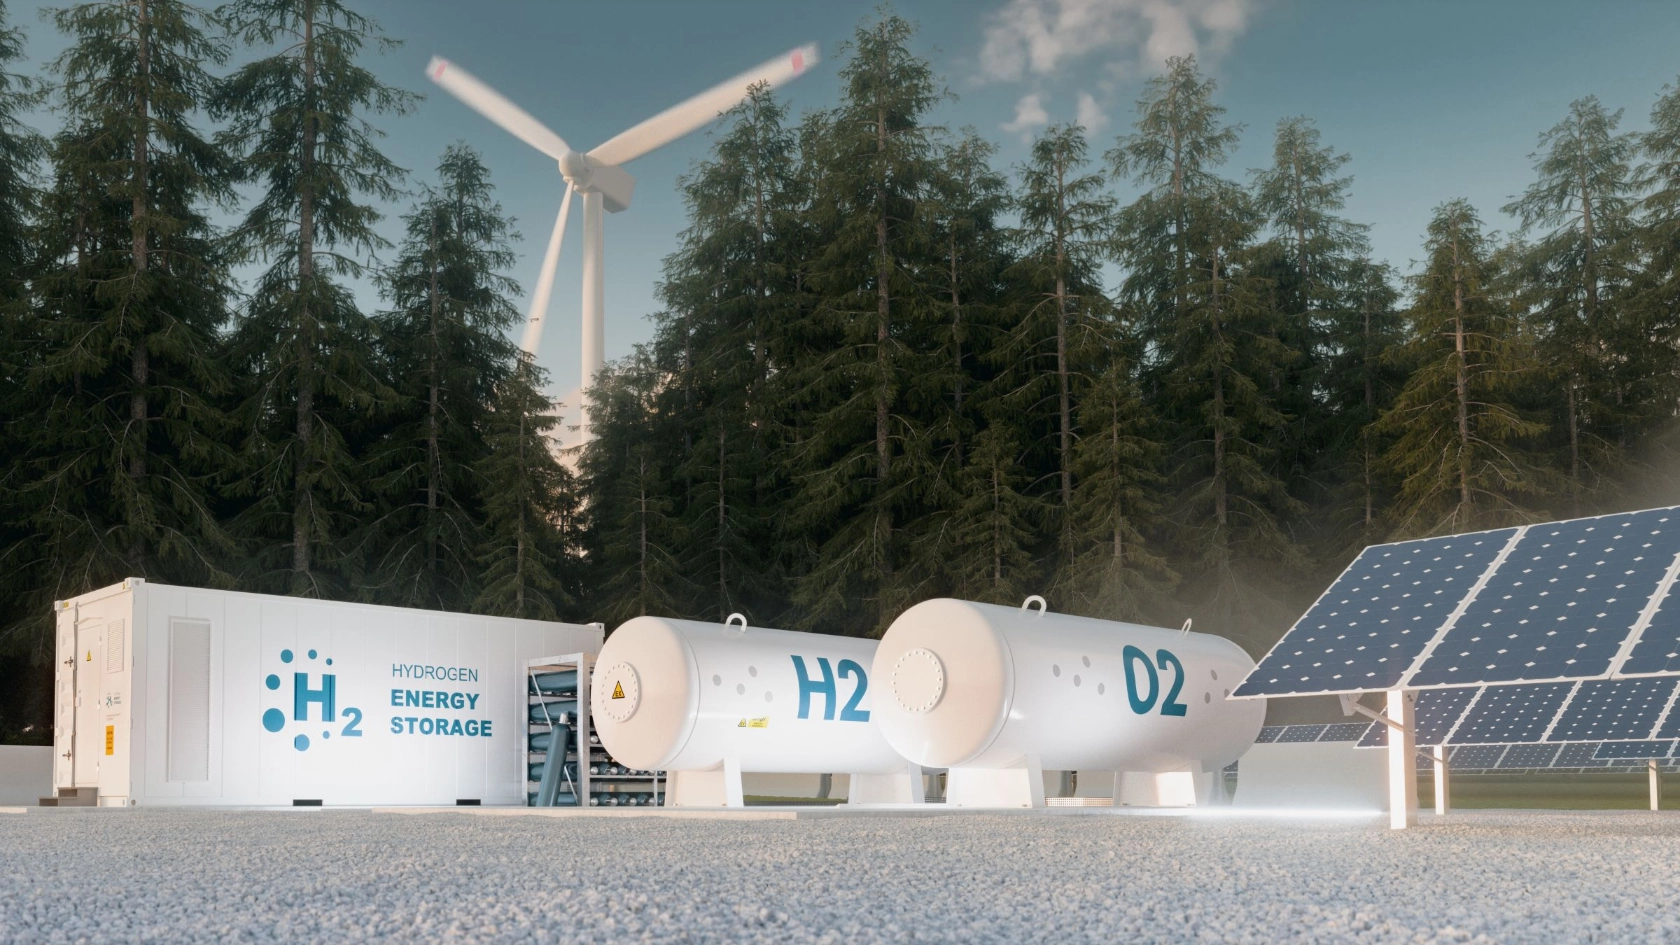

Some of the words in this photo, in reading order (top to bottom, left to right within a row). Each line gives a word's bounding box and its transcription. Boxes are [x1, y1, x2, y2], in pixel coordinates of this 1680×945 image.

[392, 663, 478, 682] HYDROGEN
[790, 654, 871, 723] H2
[294, 672, 363, 737] H2
[391, 689, 480, 710] ENERGY
[391, 716, 493, 737] STORAGE
